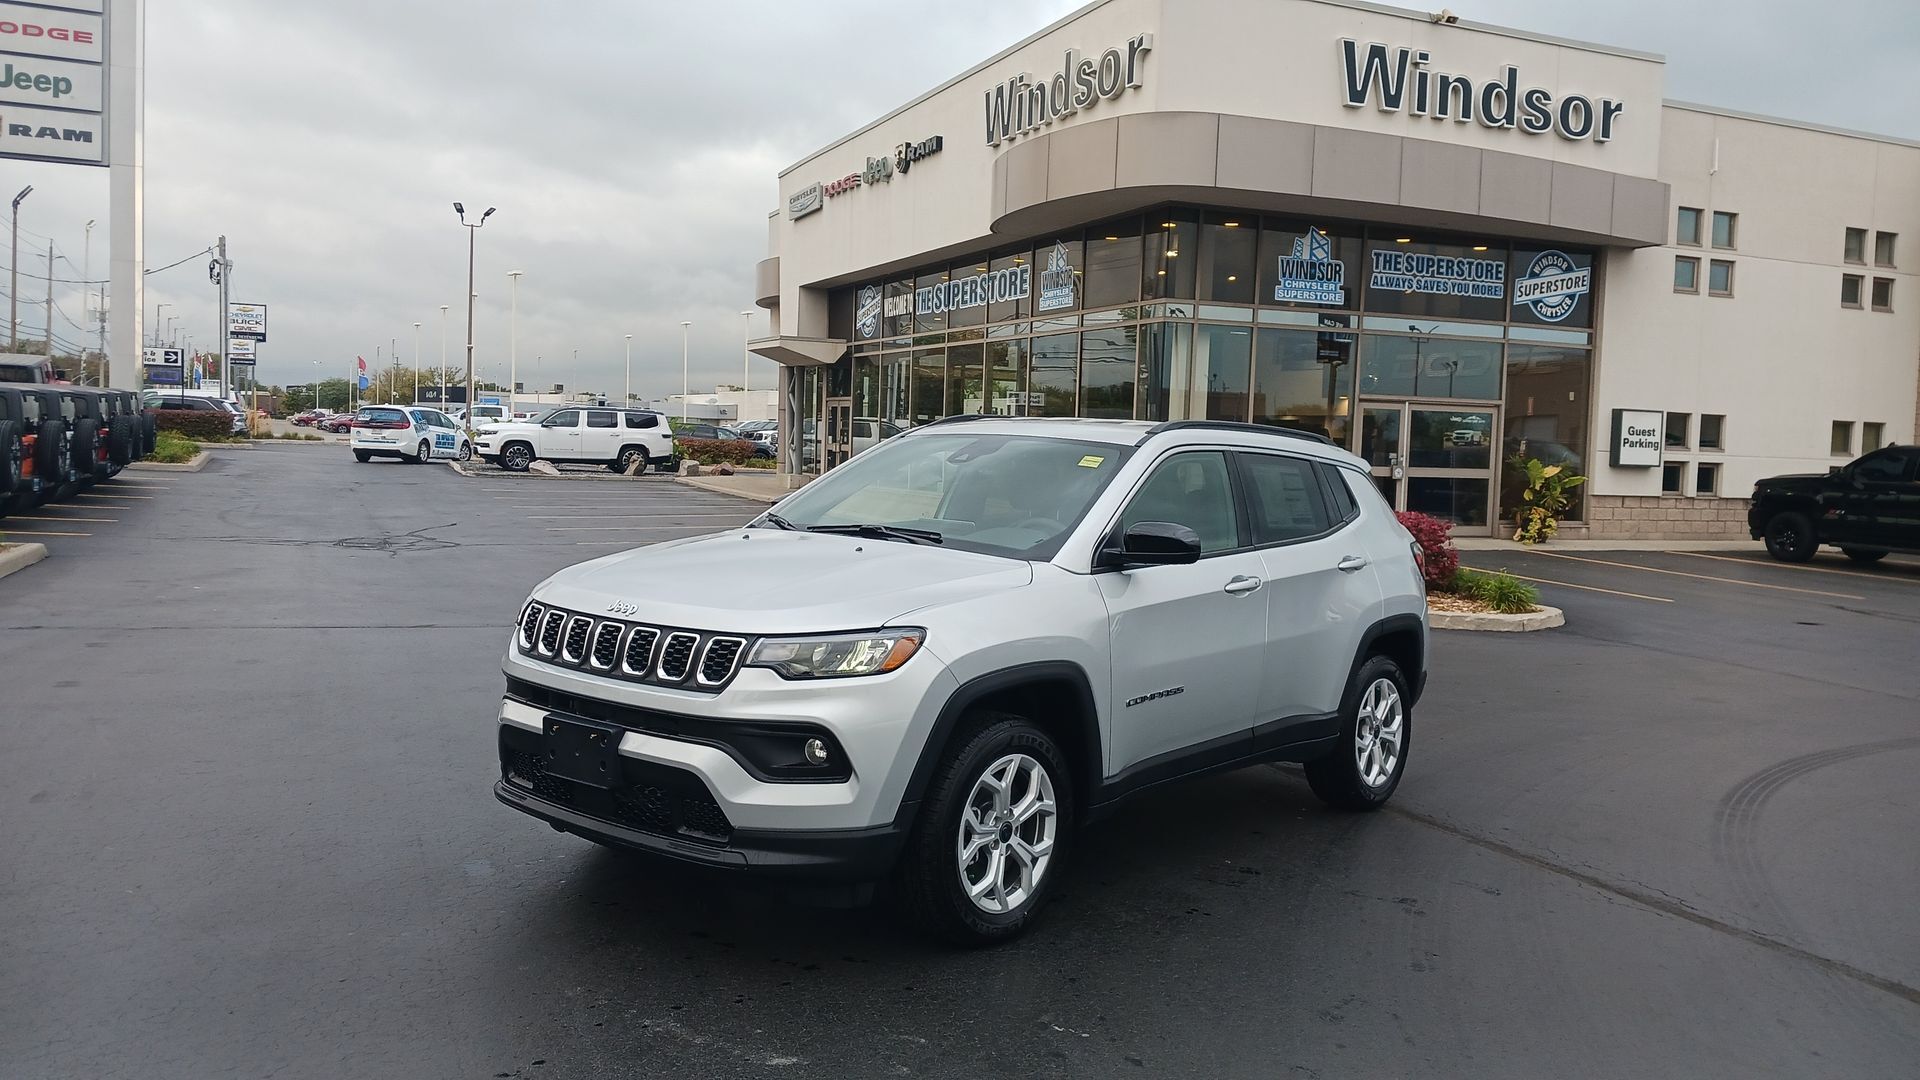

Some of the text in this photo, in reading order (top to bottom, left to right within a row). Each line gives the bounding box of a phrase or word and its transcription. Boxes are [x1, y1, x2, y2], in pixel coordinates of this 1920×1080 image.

[0, 21, 93, 44] ODGE
[0, 63, 72, 98] Jeep
[983, 32, 1153, 148] Windsor
[1337, 37, 1623, 143] Windsor
[9, 123, 92, 143] RAM
[907, 135, 943, 161] RAM
[862, 156, 893, 185] Jeep
[789, 186, 817, 205] CHRYSLER
[824, 173, 862, 199] DODGE
[1281, 259, 1341, 282] WINDSOR
[1373, 251, 1504, 281] THE SUPERSTORE
[1533, 255, 1568, 274] WINDSOR
[916, 266, 1029, 314] THE SUPERSTORE
[1278, 289, 1342, 301] SUPERSTORE
[1285, 280, 1335, 291] CHRYSLER
[1372, 274, 1503, 297] ALWAYS SAVES YOU MORE!
[1517, 275, 1587, 298] SUPERSTORE
[1537, 297, 1572, 317] CHRYSLER
[1628, 426, 1655, 436] Guest
[1623, 438, 1659, 451] Parking
[607, 600, 639, 617] Jeep
[1125, 684, 1185, 708] COMPASS
